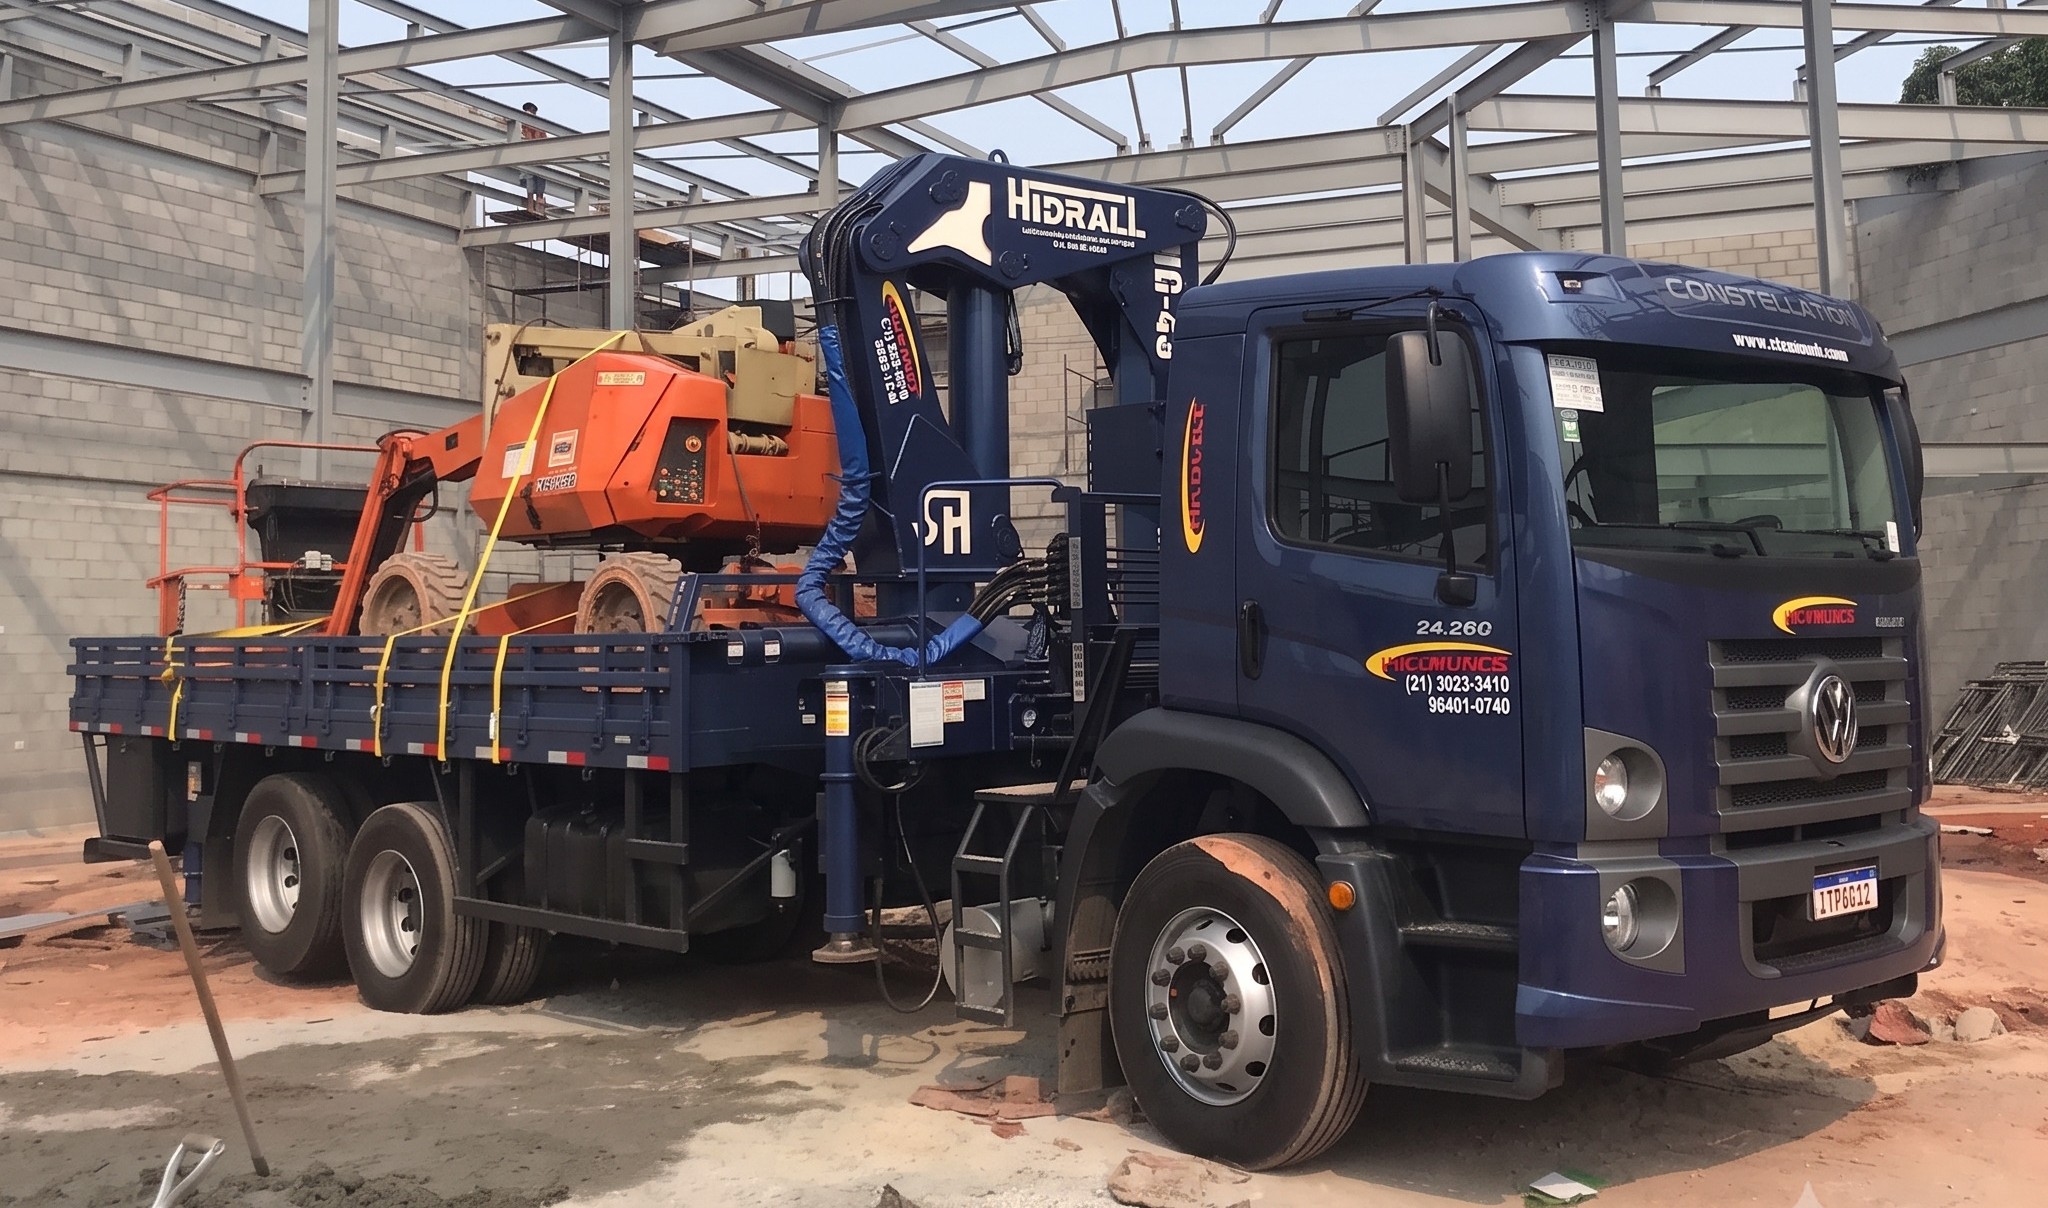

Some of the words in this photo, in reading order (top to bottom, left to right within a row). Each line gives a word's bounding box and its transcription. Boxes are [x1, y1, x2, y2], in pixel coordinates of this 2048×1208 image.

[1007, 177, 1147, 239] HIDRALL
[1665, 277, 1857, 328] CONSTELLATION
[1416, 620, 1492, 636] 24.260
[1405, 674, 1433, 695] (21)
[1436, 675, 1510, 693] 3023-3410
[1428, 696, 1511, 714] 96401-0740
[1820, 882, 1871, 914] ITP6G12
